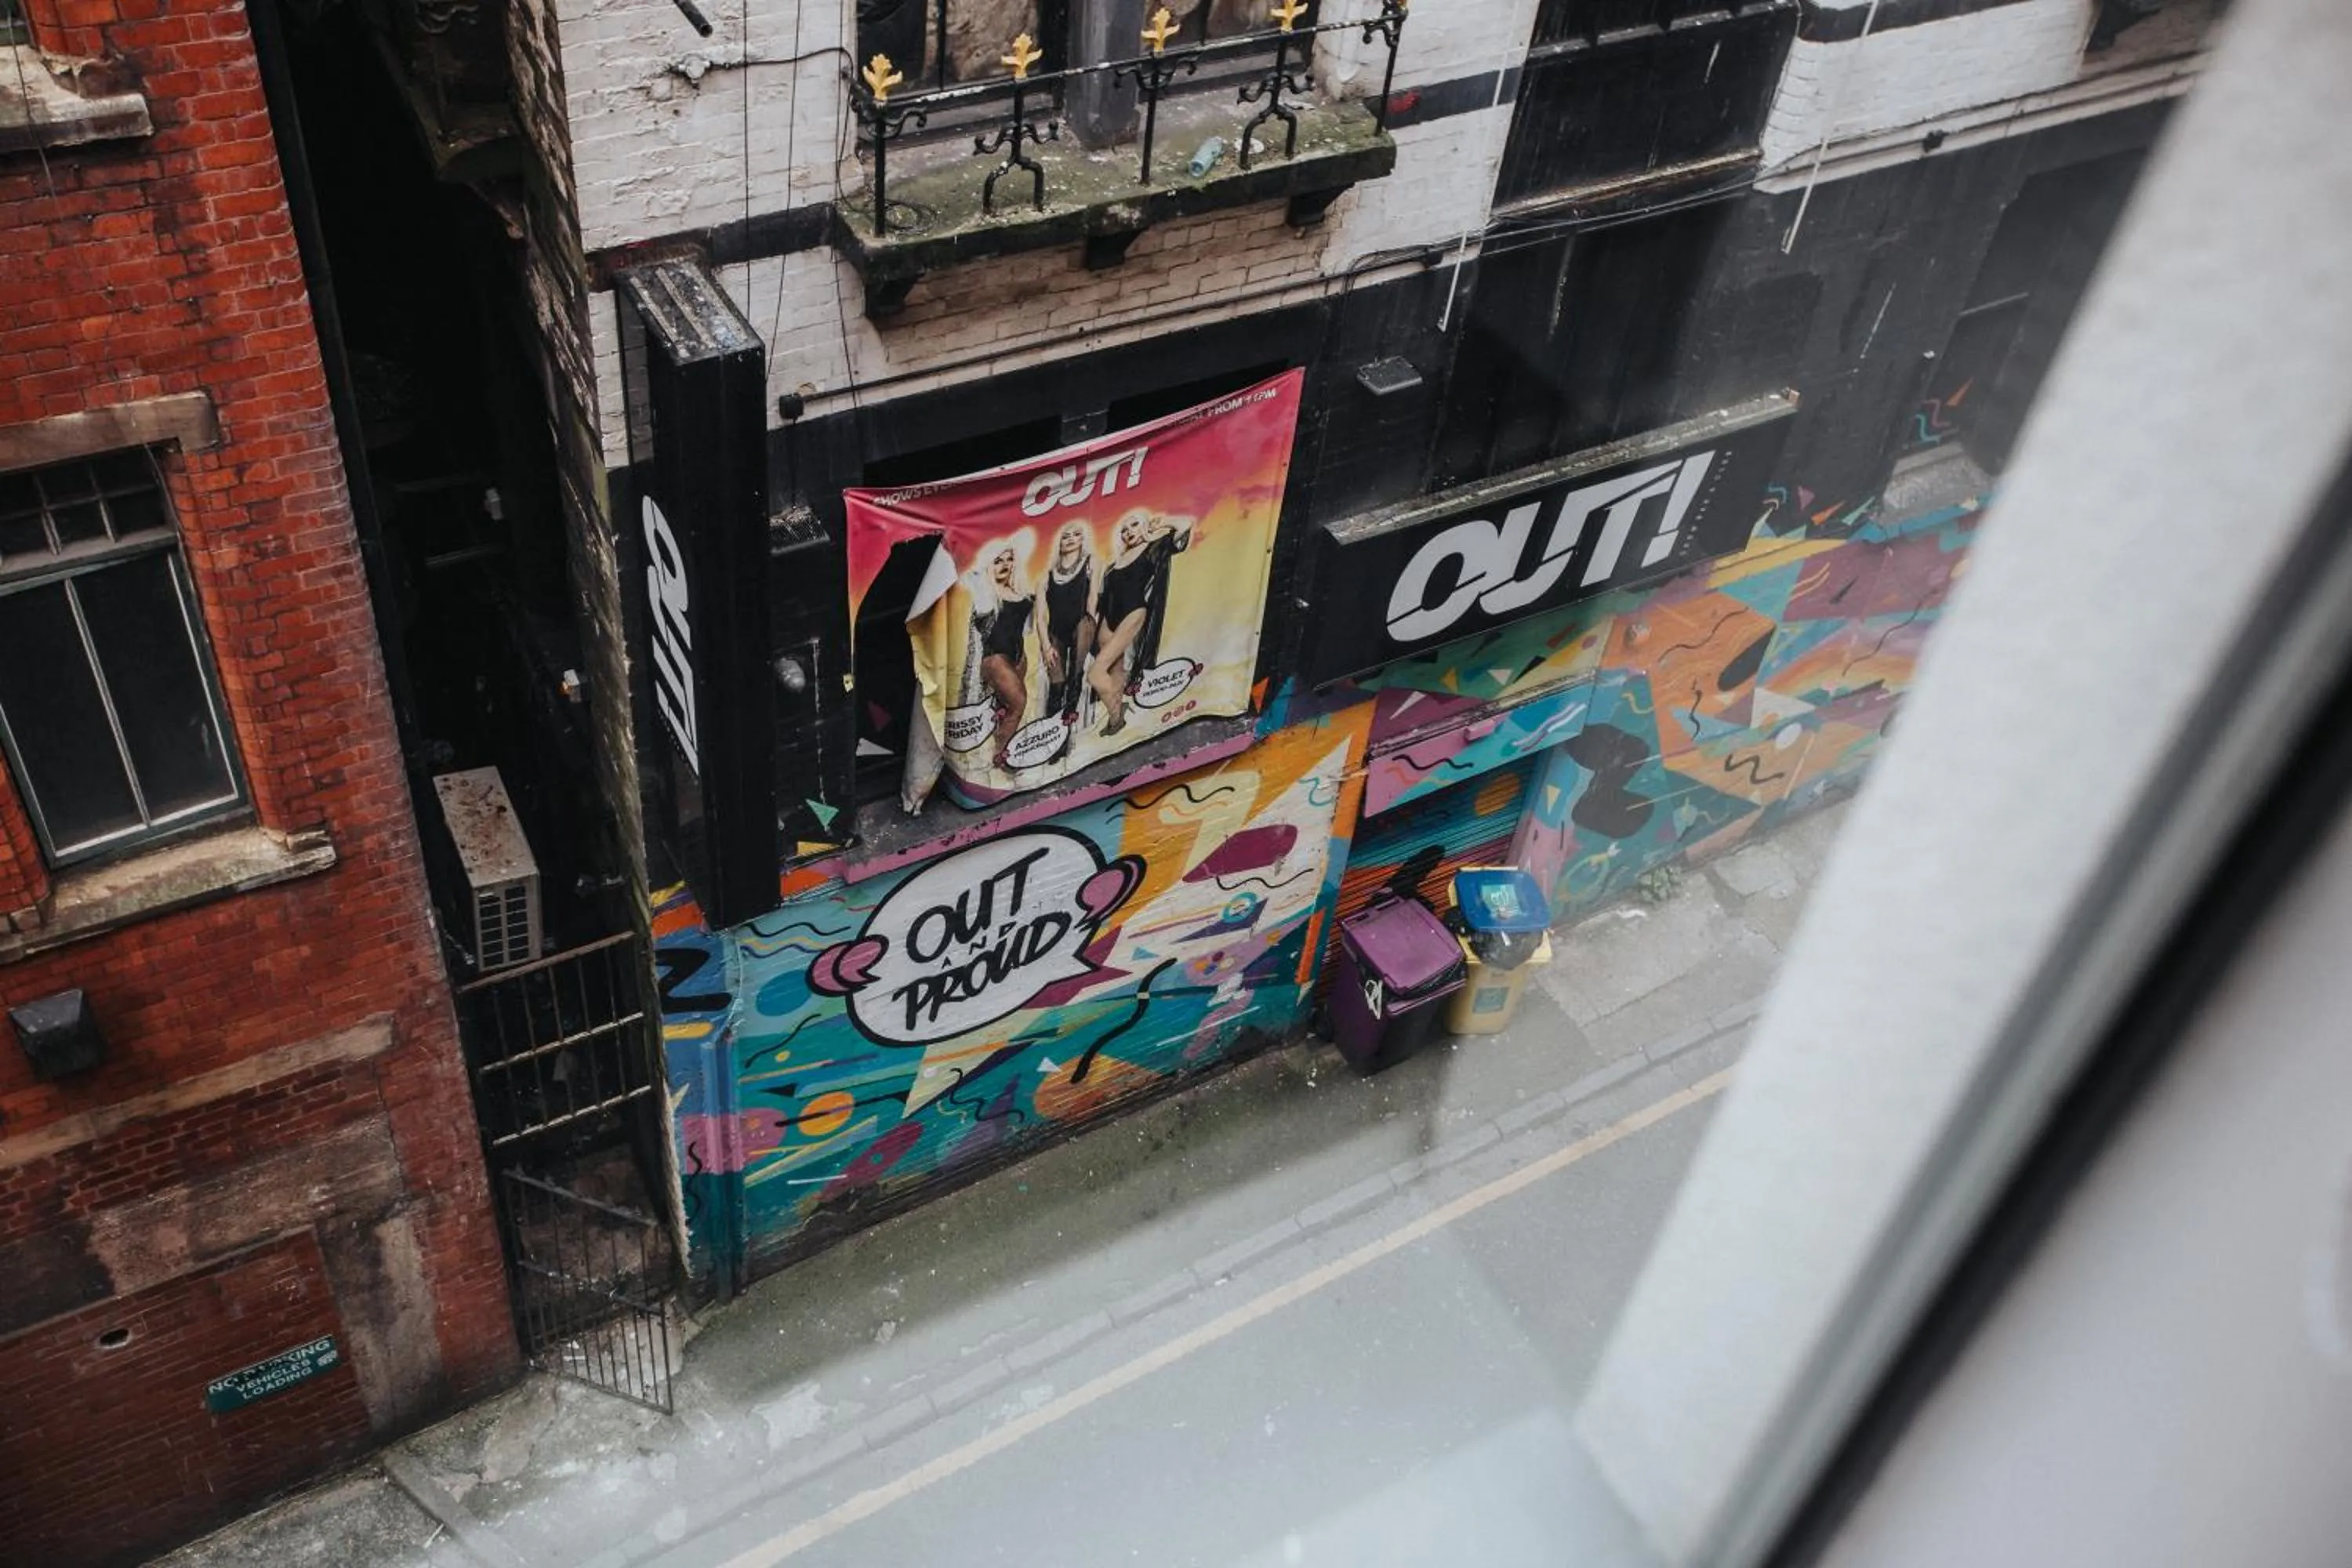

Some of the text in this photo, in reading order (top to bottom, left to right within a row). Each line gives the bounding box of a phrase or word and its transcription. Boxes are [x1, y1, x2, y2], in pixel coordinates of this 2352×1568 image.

[1022, 446, 1149, 517] OUT!
[1387, 450, 1716, 642] OUT!
[642, 495, 699, 776] OUT!
[1148, 669, 1186, 688] VIOLET
[1015, 725, 1060, 750] AZZURO
[906, 847, 1051, 964] OUT
[891, 911, 1073, 1031] PROUD
[236, 1359, 311, 1393] VEHICLES
[242, 1367, 313, 1400] LOADING
